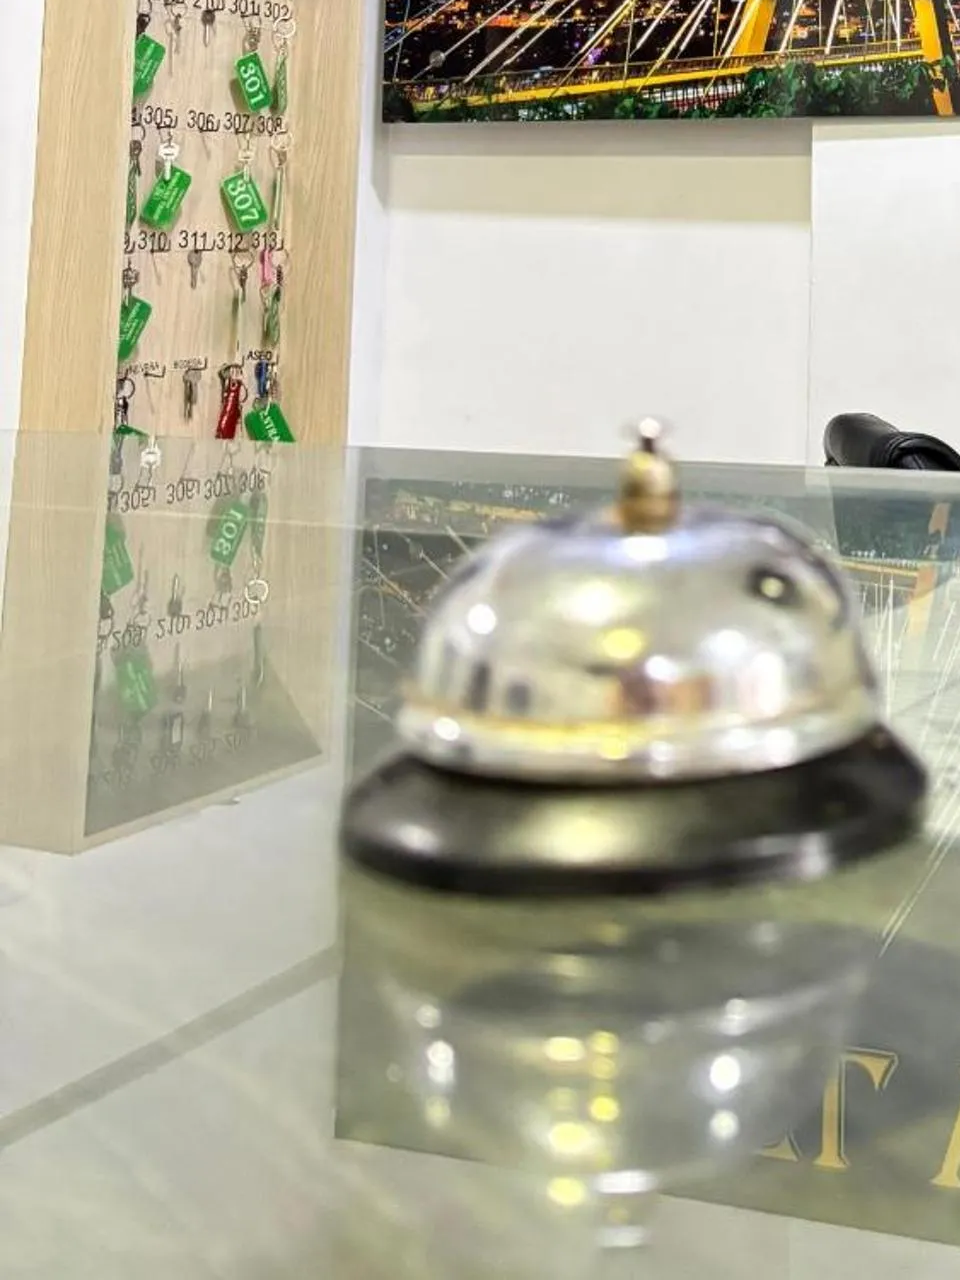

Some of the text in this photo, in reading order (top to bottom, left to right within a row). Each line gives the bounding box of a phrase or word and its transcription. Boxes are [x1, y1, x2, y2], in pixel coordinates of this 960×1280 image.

[240, 62, 264, 103] 301
[144, 106, 173, 127] 305
[187, 110, 215, 130] 306
[224, 112, 250, 132] 307
[228, 180, 259, 222] 307
[138, 230, 167, 250] 310
[179, 230, 207, 250] 311
[216, 231, 242, 251] 312
[252, 231, 277, 251] 313
